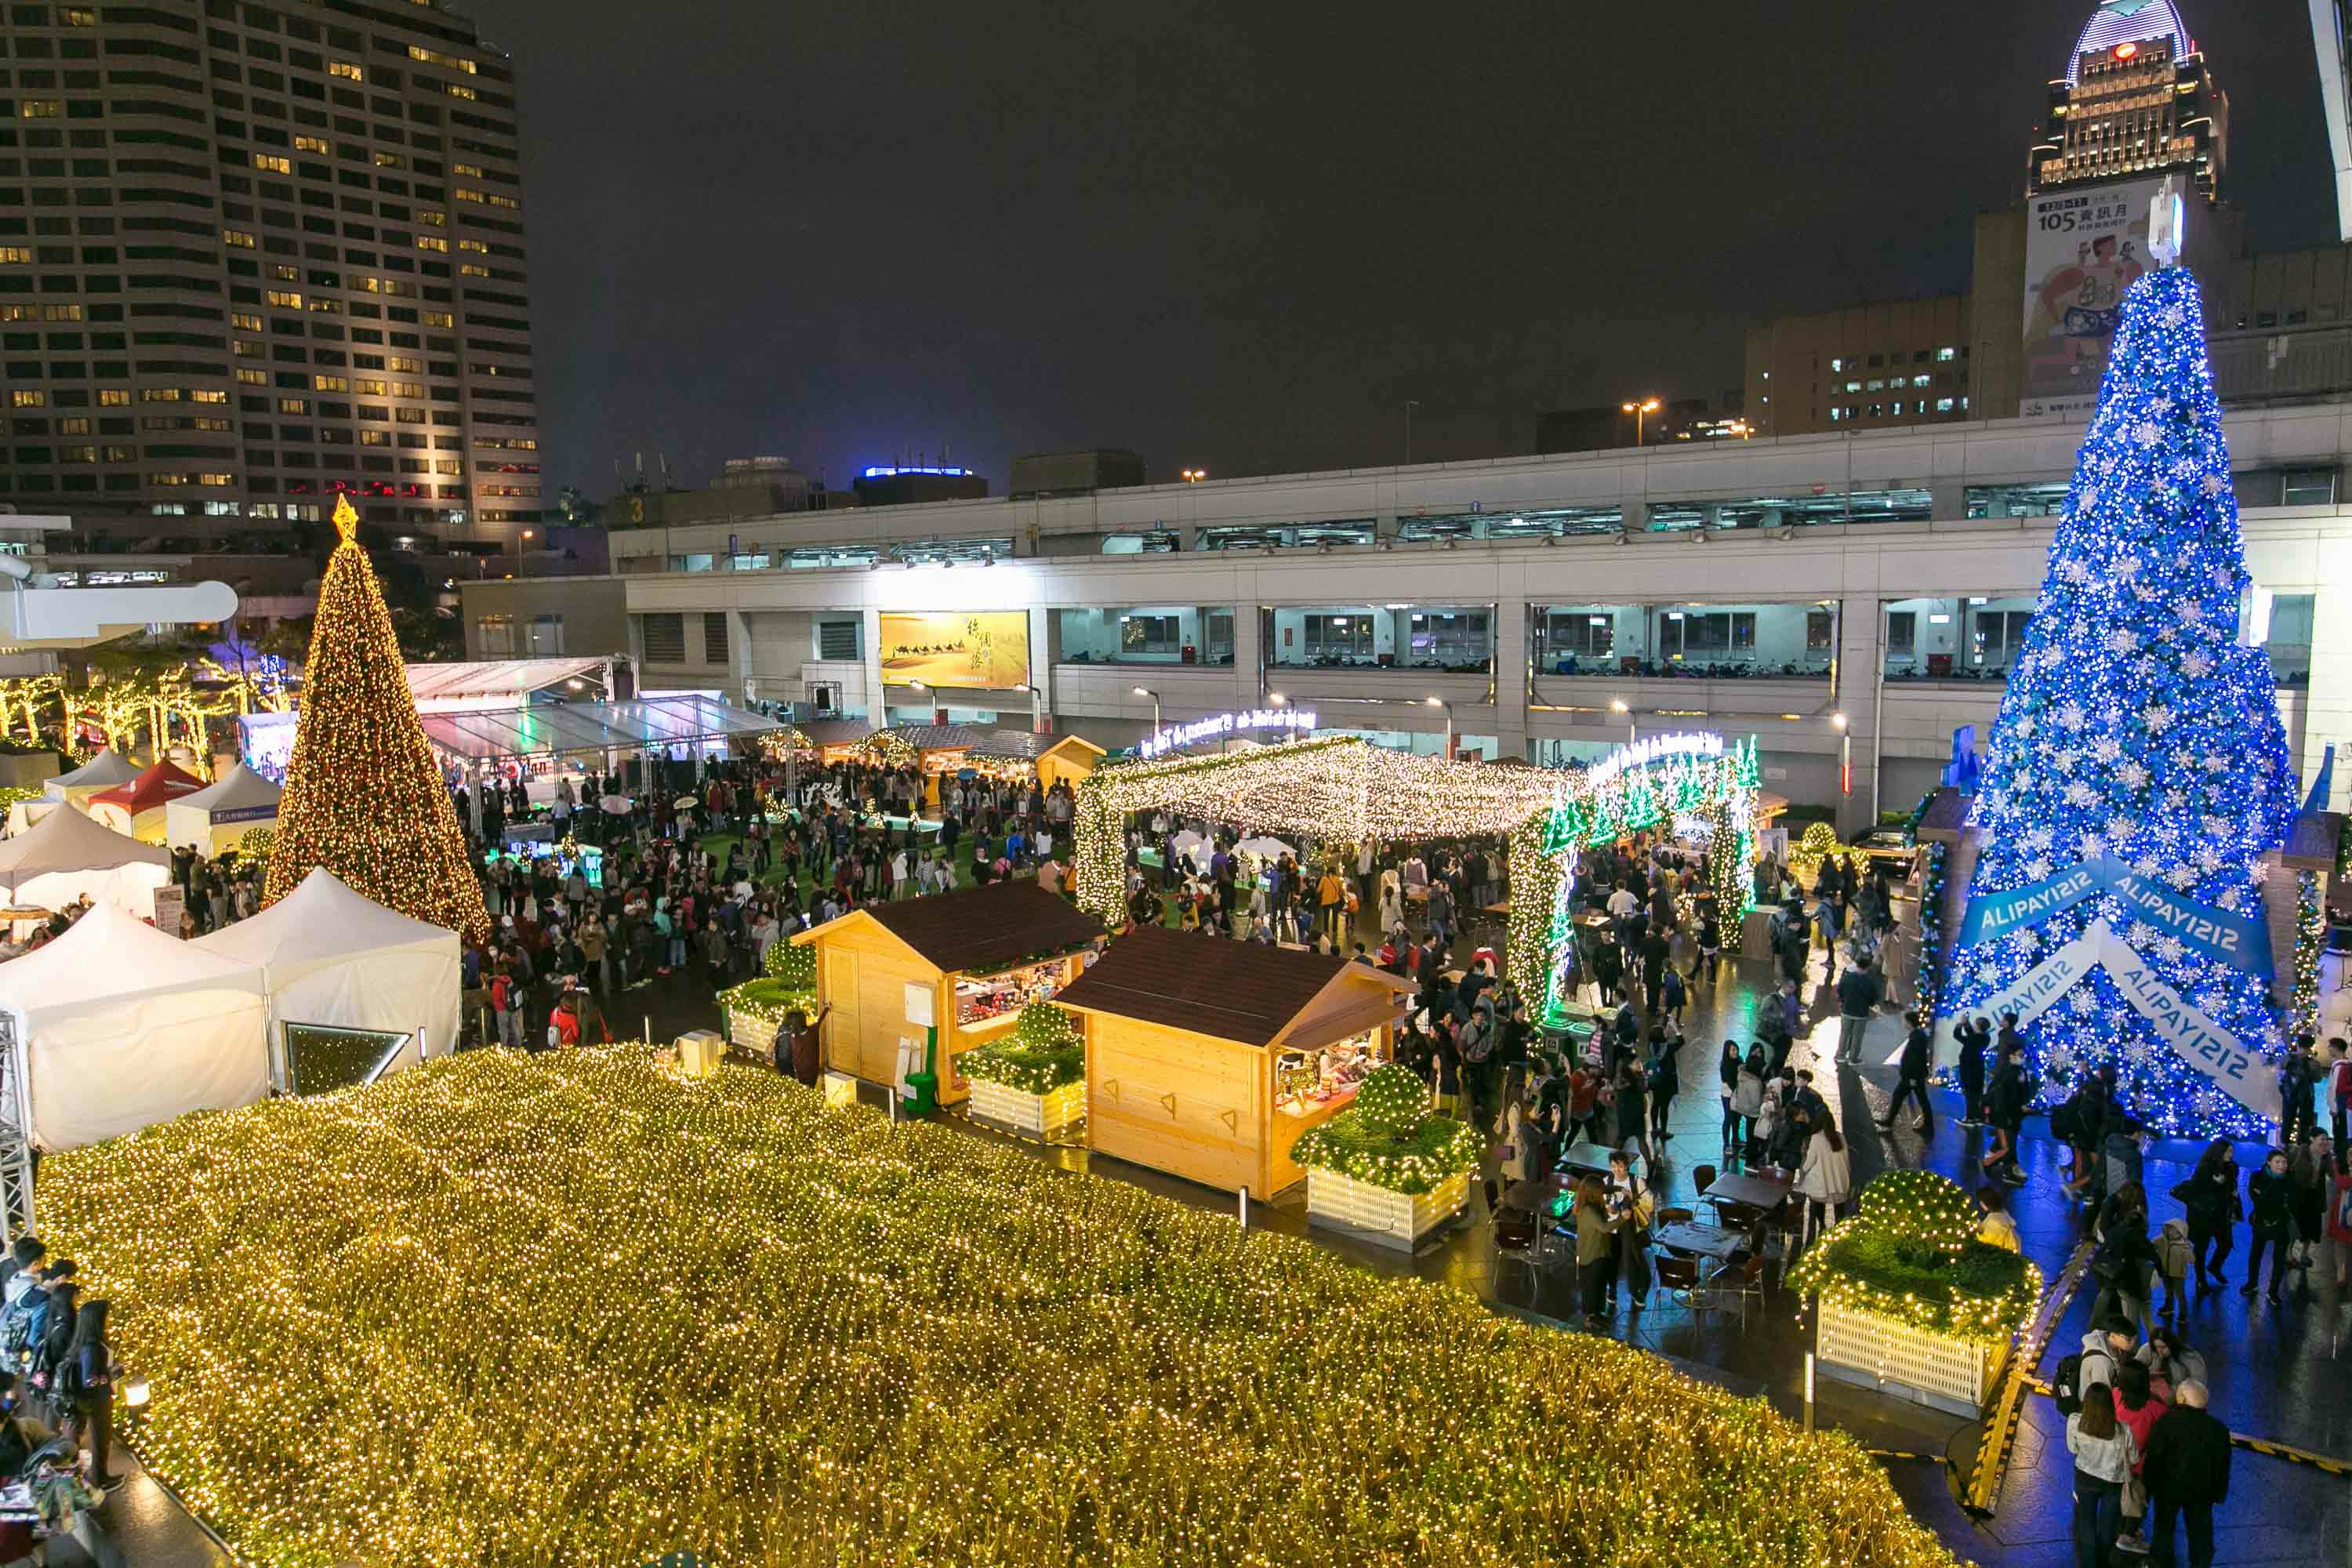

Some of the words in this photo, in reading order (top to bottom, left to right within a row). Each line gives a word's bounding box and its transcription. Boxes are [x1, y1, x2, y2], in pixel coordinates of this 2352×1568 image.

[2038, 212, 2076, 232] 105
[1982, 871, 2093, 929] ALIPAY1212
[2114, 877, 2239, 953] ALIPAY1212
[2124, 970, 2249, 1080] ALIPAY1212
